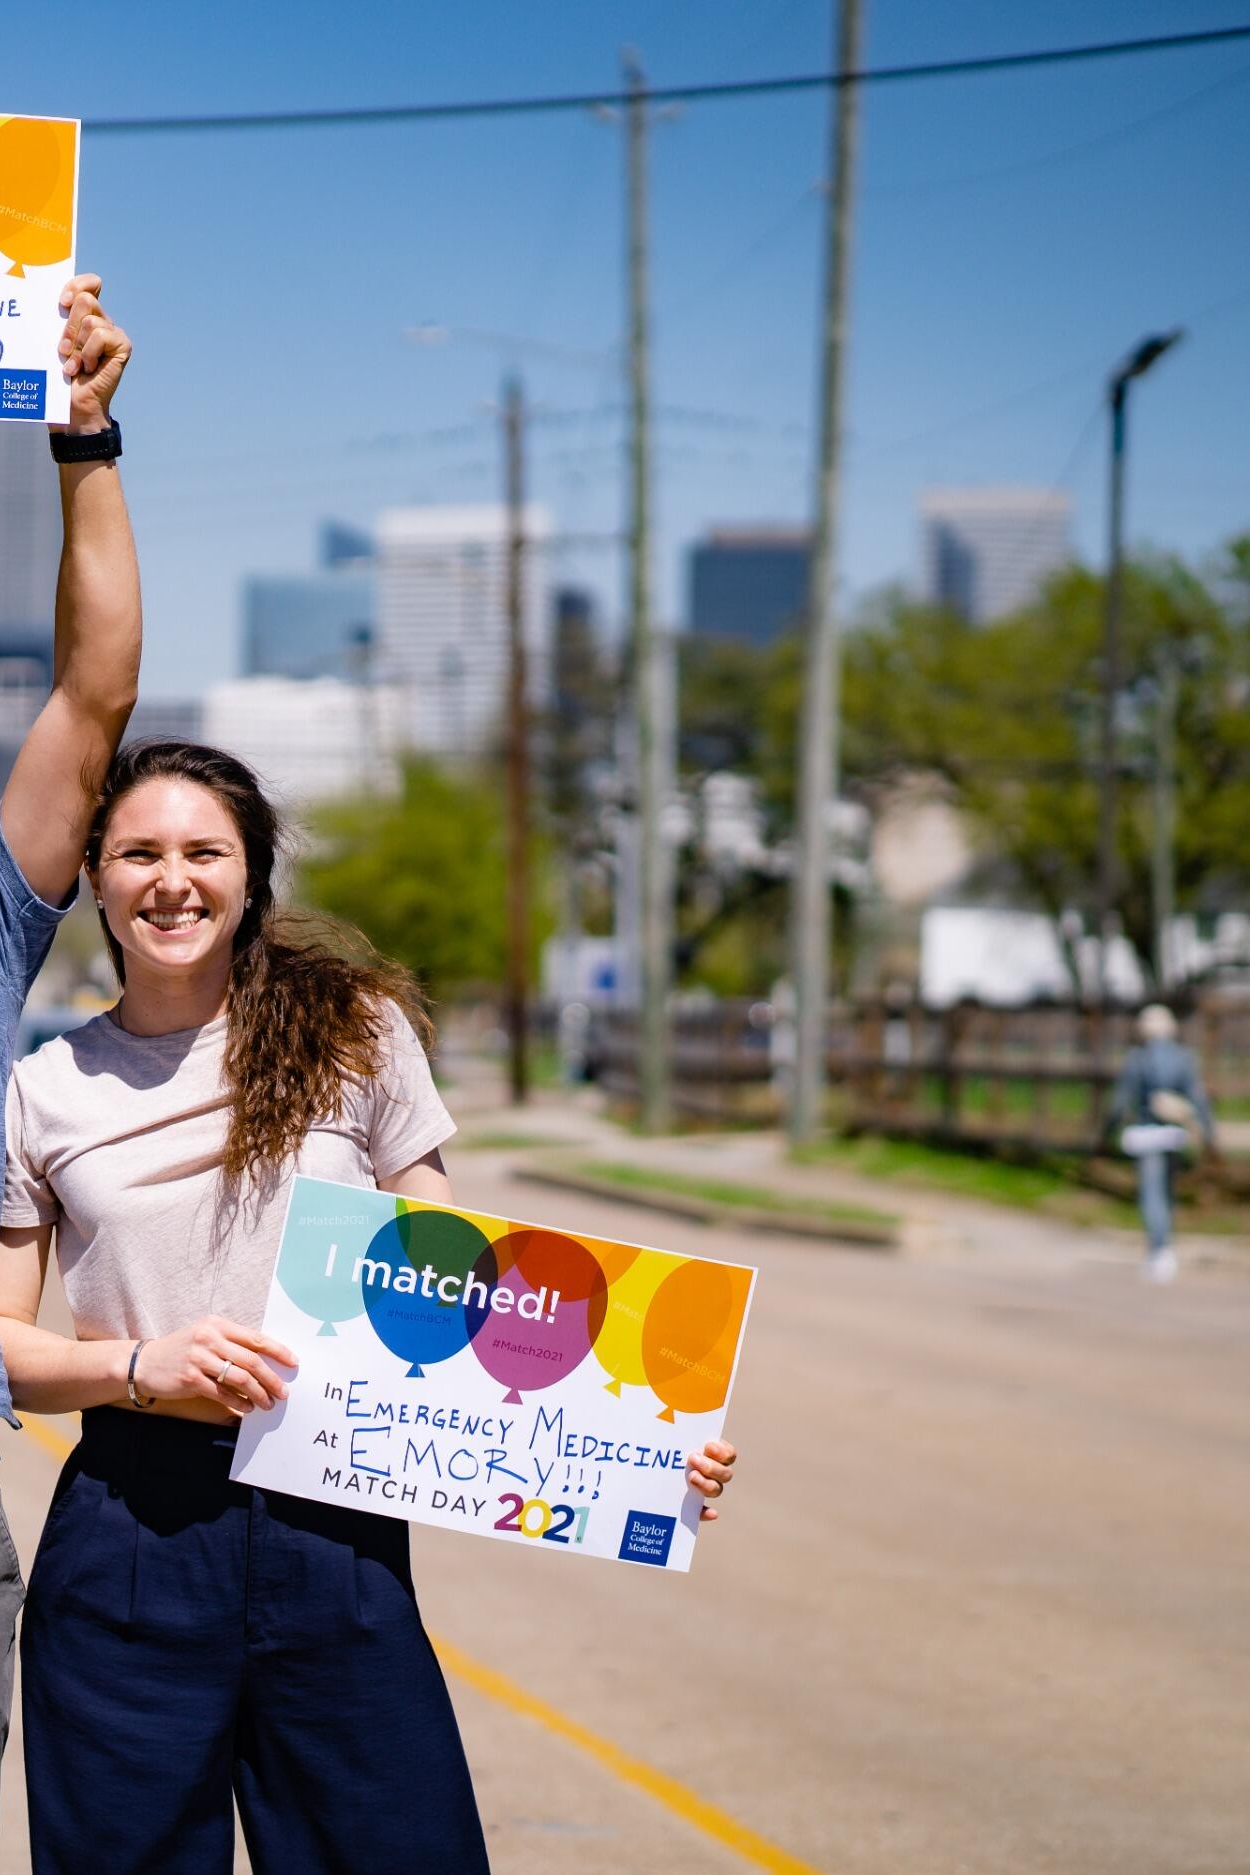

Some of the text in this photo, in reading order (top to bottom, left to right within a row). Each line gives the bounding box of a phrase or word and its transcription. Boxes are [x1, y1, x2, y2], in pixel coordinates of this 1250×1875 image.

[2, 379, 40, 393] Baylor
[2, 392, 38, 401] College of
[2, 401, 39, 410] Medicine
[325, 1243, 561, 1324] I matched!
[492, 1339, 564, 1363] #Match2021
[324, 1382, 343, 1401] In
[346, 1380, 686, 1470] EMERGENCY MEDICINE
[313, 1429, 339, 1449] At
[350, 1426, 602, 1500] EMORY!!!
[322, 1467, 591, 1544] MATCH DAY 2021
[631, 1521, 668, 1538] Baylor
[627, 1542, 663, 1556] Medicine
[629, 1533, 665, 1546] College of
